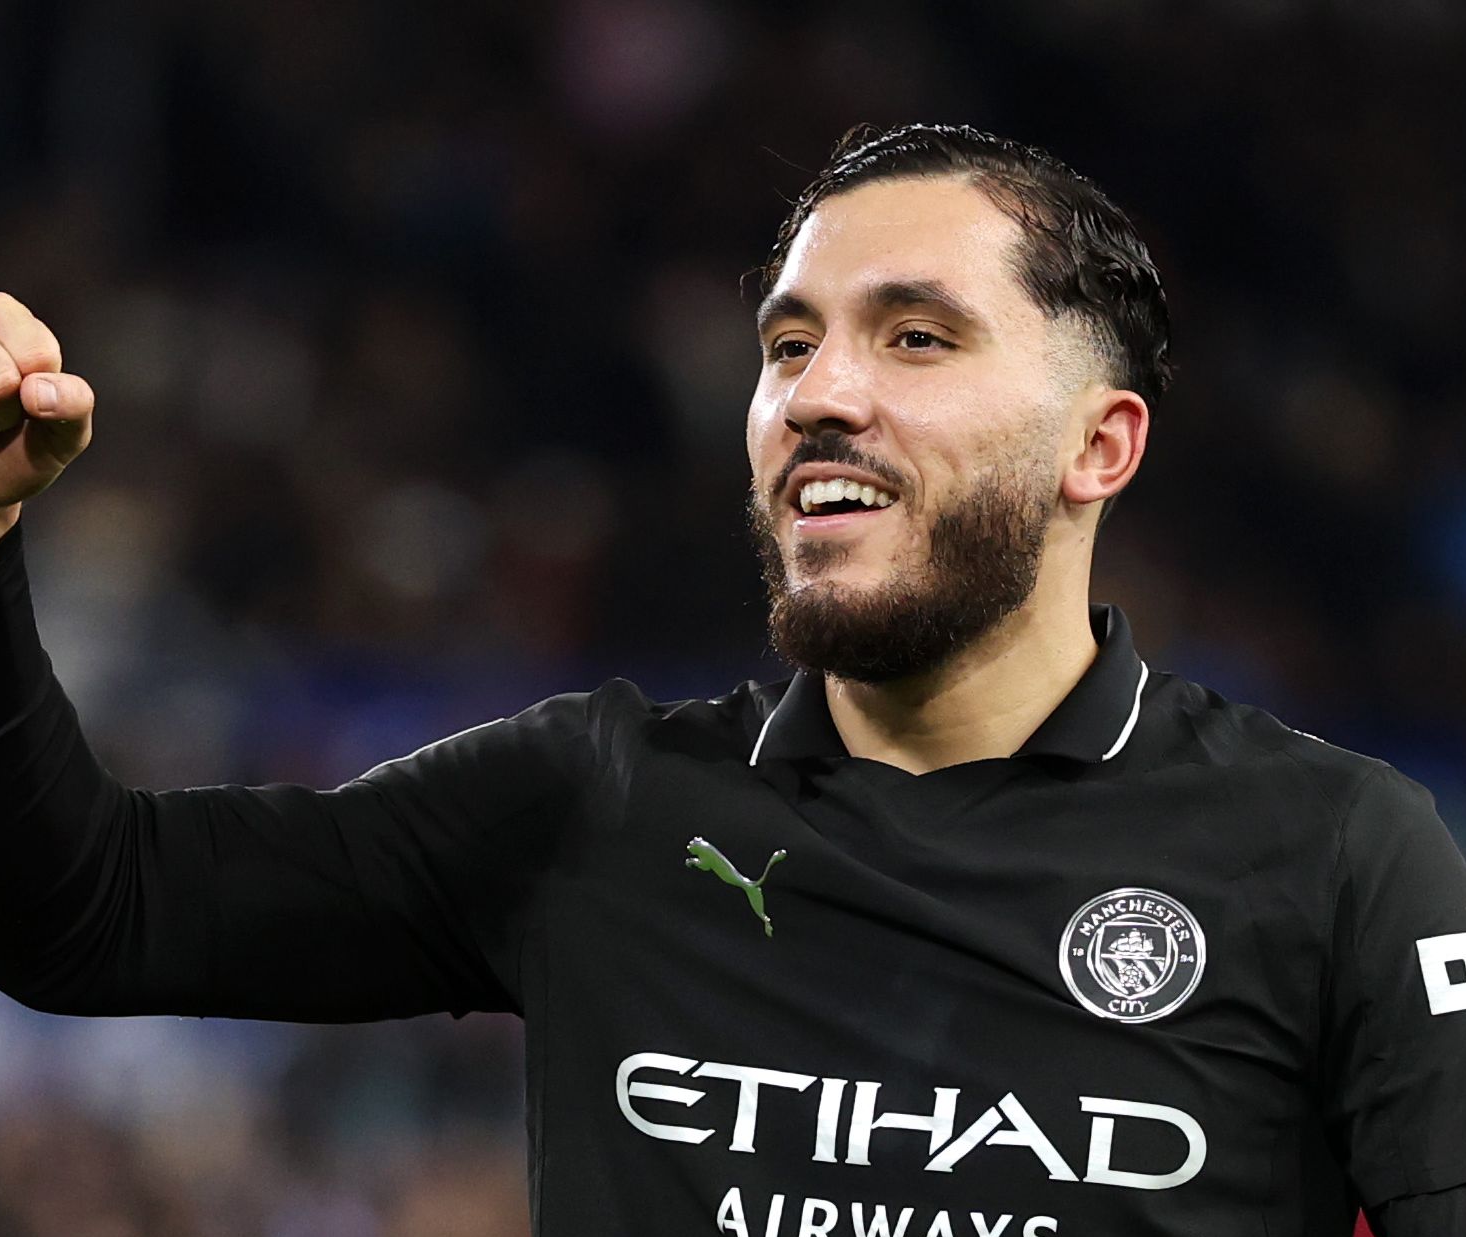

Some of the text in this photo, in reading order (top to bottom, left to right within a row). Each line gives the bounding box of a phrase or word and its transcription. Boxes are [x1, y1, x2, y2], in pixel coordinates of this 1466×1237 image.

[1079, 899, 1190, 941] MANCHESTER
[1107, 999, 1150, 1014] CITY
[616, 1052, 1207, 1190] ETIHAD
